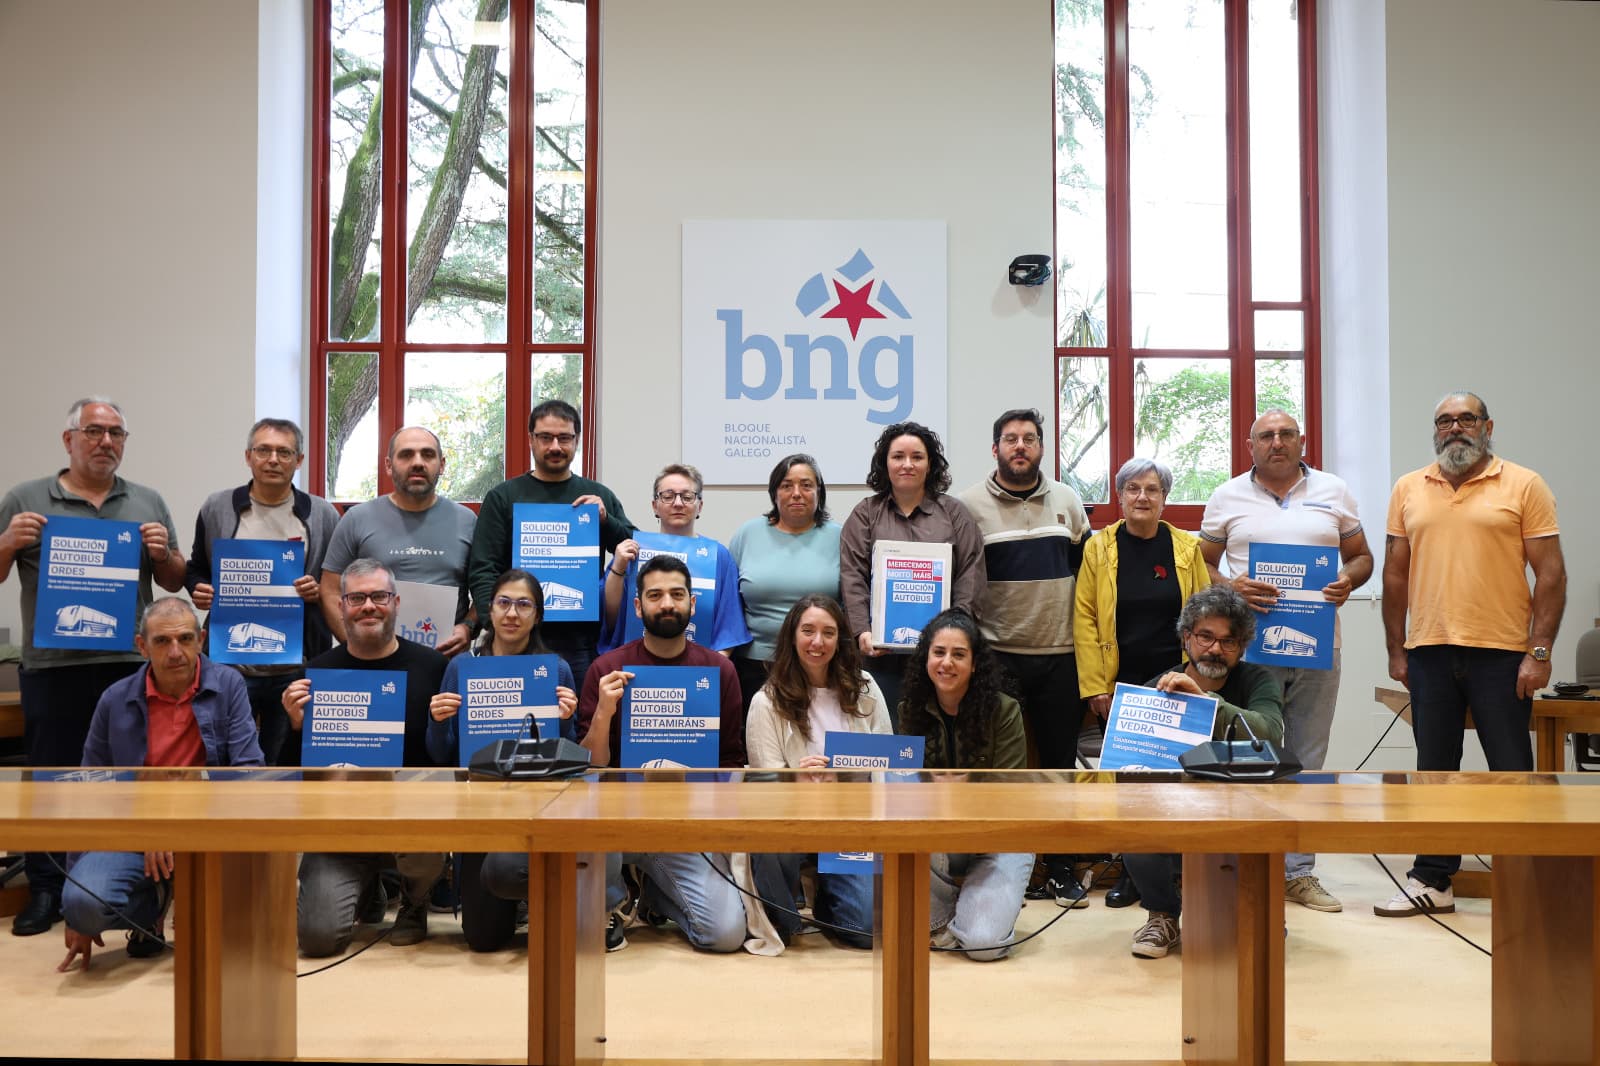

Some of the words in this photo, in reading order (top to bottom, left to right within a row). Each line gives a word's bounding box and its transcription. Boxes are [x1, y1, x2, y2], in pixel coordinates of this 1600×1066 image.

[716, 309, 914, 425] bng
[724, 423, 771, 433] BLOQUE
[724, 435, 807, 445] NACIONALISTA
[724, 448, 771, 457] GALEGO
[522, 522, 568, 532] SOLUCIÓN
[52, 538, 106, 550] SOLUCIÓN
[522, 534, 565, 544] AUTOBÚS
[522, 547, 552, 556] ORDES
[51, 552, 101, 563] AUTOBÚS
[222, 560, 271, 570] SOLUCIÓN
[887, 561, 932, 569] MERECEMOS
[1257, 563, 1304, 574] SOLUCIÓN
[50, 566, 86, 576] ORDES
[913, 571, 932, 579] MÁIS
[222, 572, 268, 583] AUTOBÚS
[221, 585, 252, 595] BRIÓN
[894, 582, 934, 592] SOLUCIÓN
[894, 593, 932, 602] AUTOBÚS
[401, 624, 438, 648] bng
[469, 679, 522, 690] SOLUCIÓN
[315, 692, 369, 703] SOLUCIÓN
[469, 693, 519, 705] AUTOBÚS
[633, 688, 684, 699] SOLUCIÓN
[633, 702, 681, 713] AUTOBÚS
[1126, 696, 1179, 711] SOLUCIÓN
[315, 706, 365, 717] AUTOBÚS
[470, 709, 504, 719] ORDES
[1122, 709, 1173, 723] AUTOBÚS
[314, 722, 350, 731] ORDES
[632, 717, 706, 728] BERTAMIRÁNS
[1120, 721, 1155, 734] VEDRA
[835, 756, 887, 768] SOLUCIÓN
